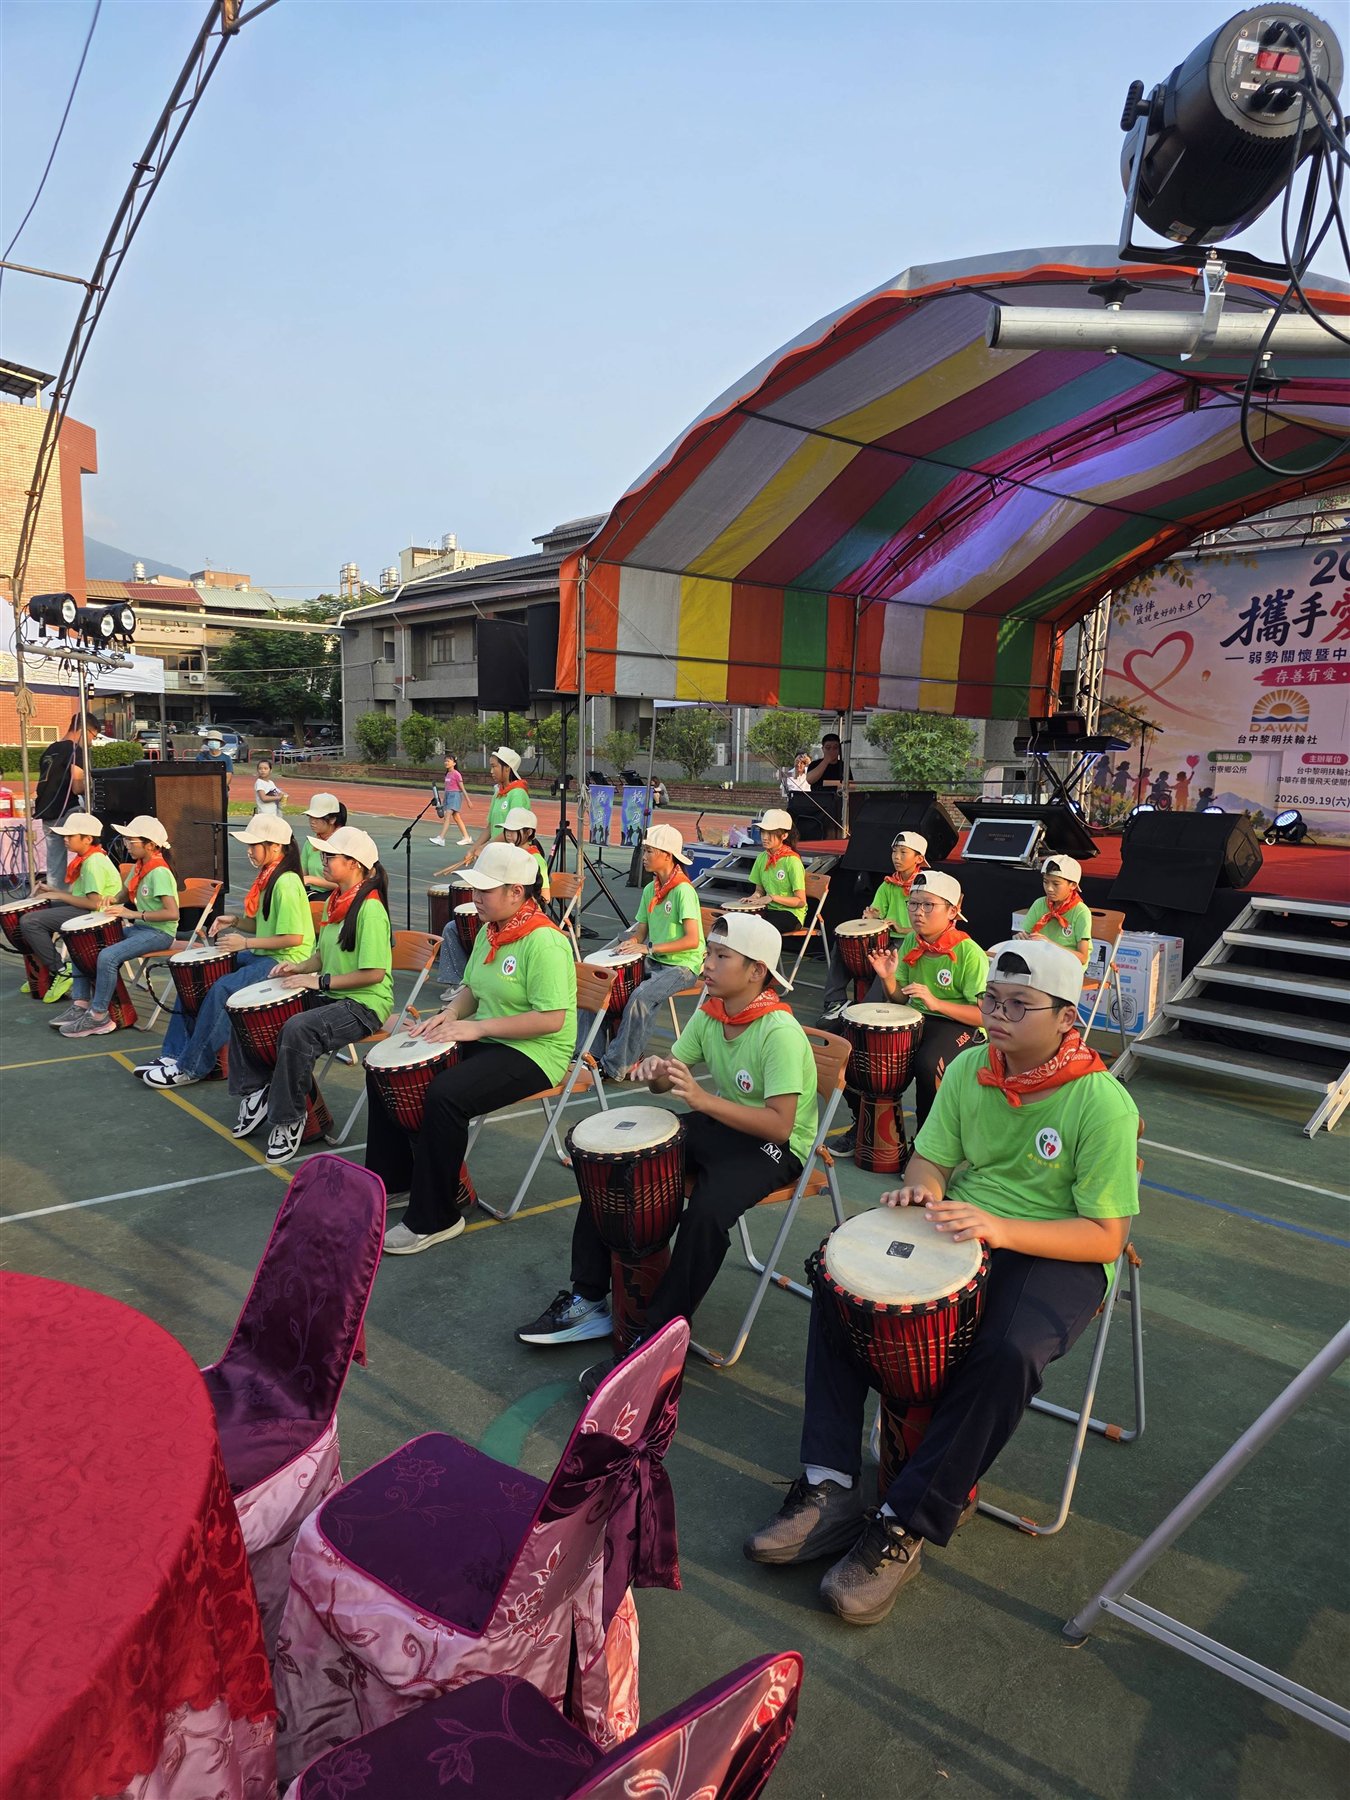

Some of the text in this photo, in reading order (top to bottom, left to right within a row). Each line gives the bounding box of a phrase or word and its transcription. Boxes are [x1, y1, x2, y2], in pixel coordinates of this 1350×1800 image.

[1133, 600, 1155, 616] 陪伴
[1238, 734, 1318, 745] 台中黎明扶輪社
